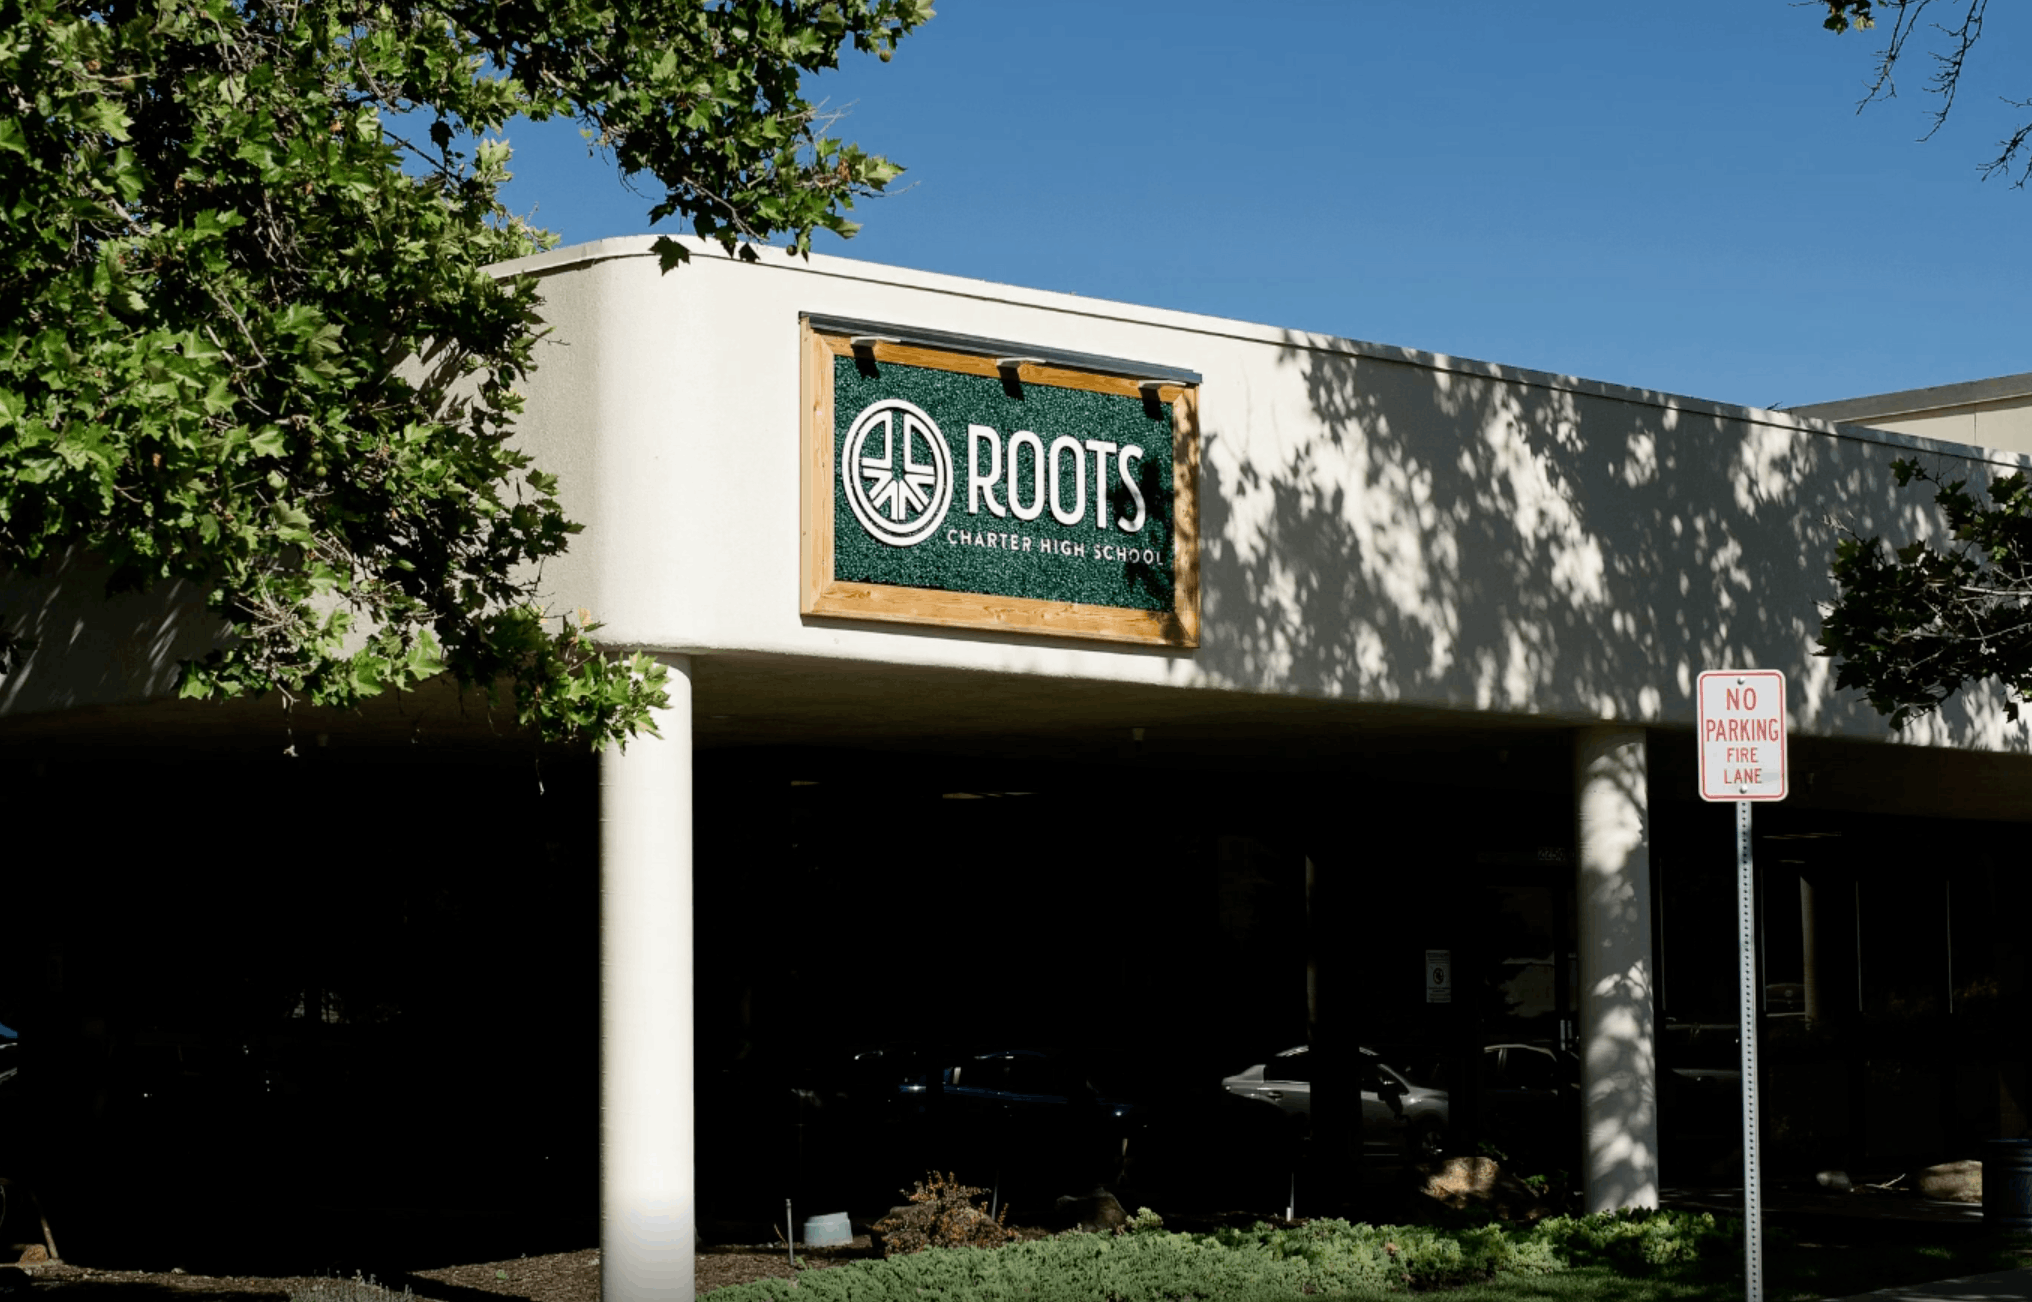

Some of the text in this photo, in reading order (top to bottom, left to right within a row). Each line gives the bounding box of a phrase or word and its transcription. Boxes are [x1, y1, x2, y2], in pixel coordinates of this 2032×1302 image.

[967, 423, 1146, 532] ROOTS
[947, 529, 1163, 565] CHARTER HIGH SCHOOL
[1727, 687, 1757, 710] NO
[1706, 718, 1779, 742] PARKING
[1727, 747, 1758, 763] FIRE
[1724, 768, 1762, 784] LANE
